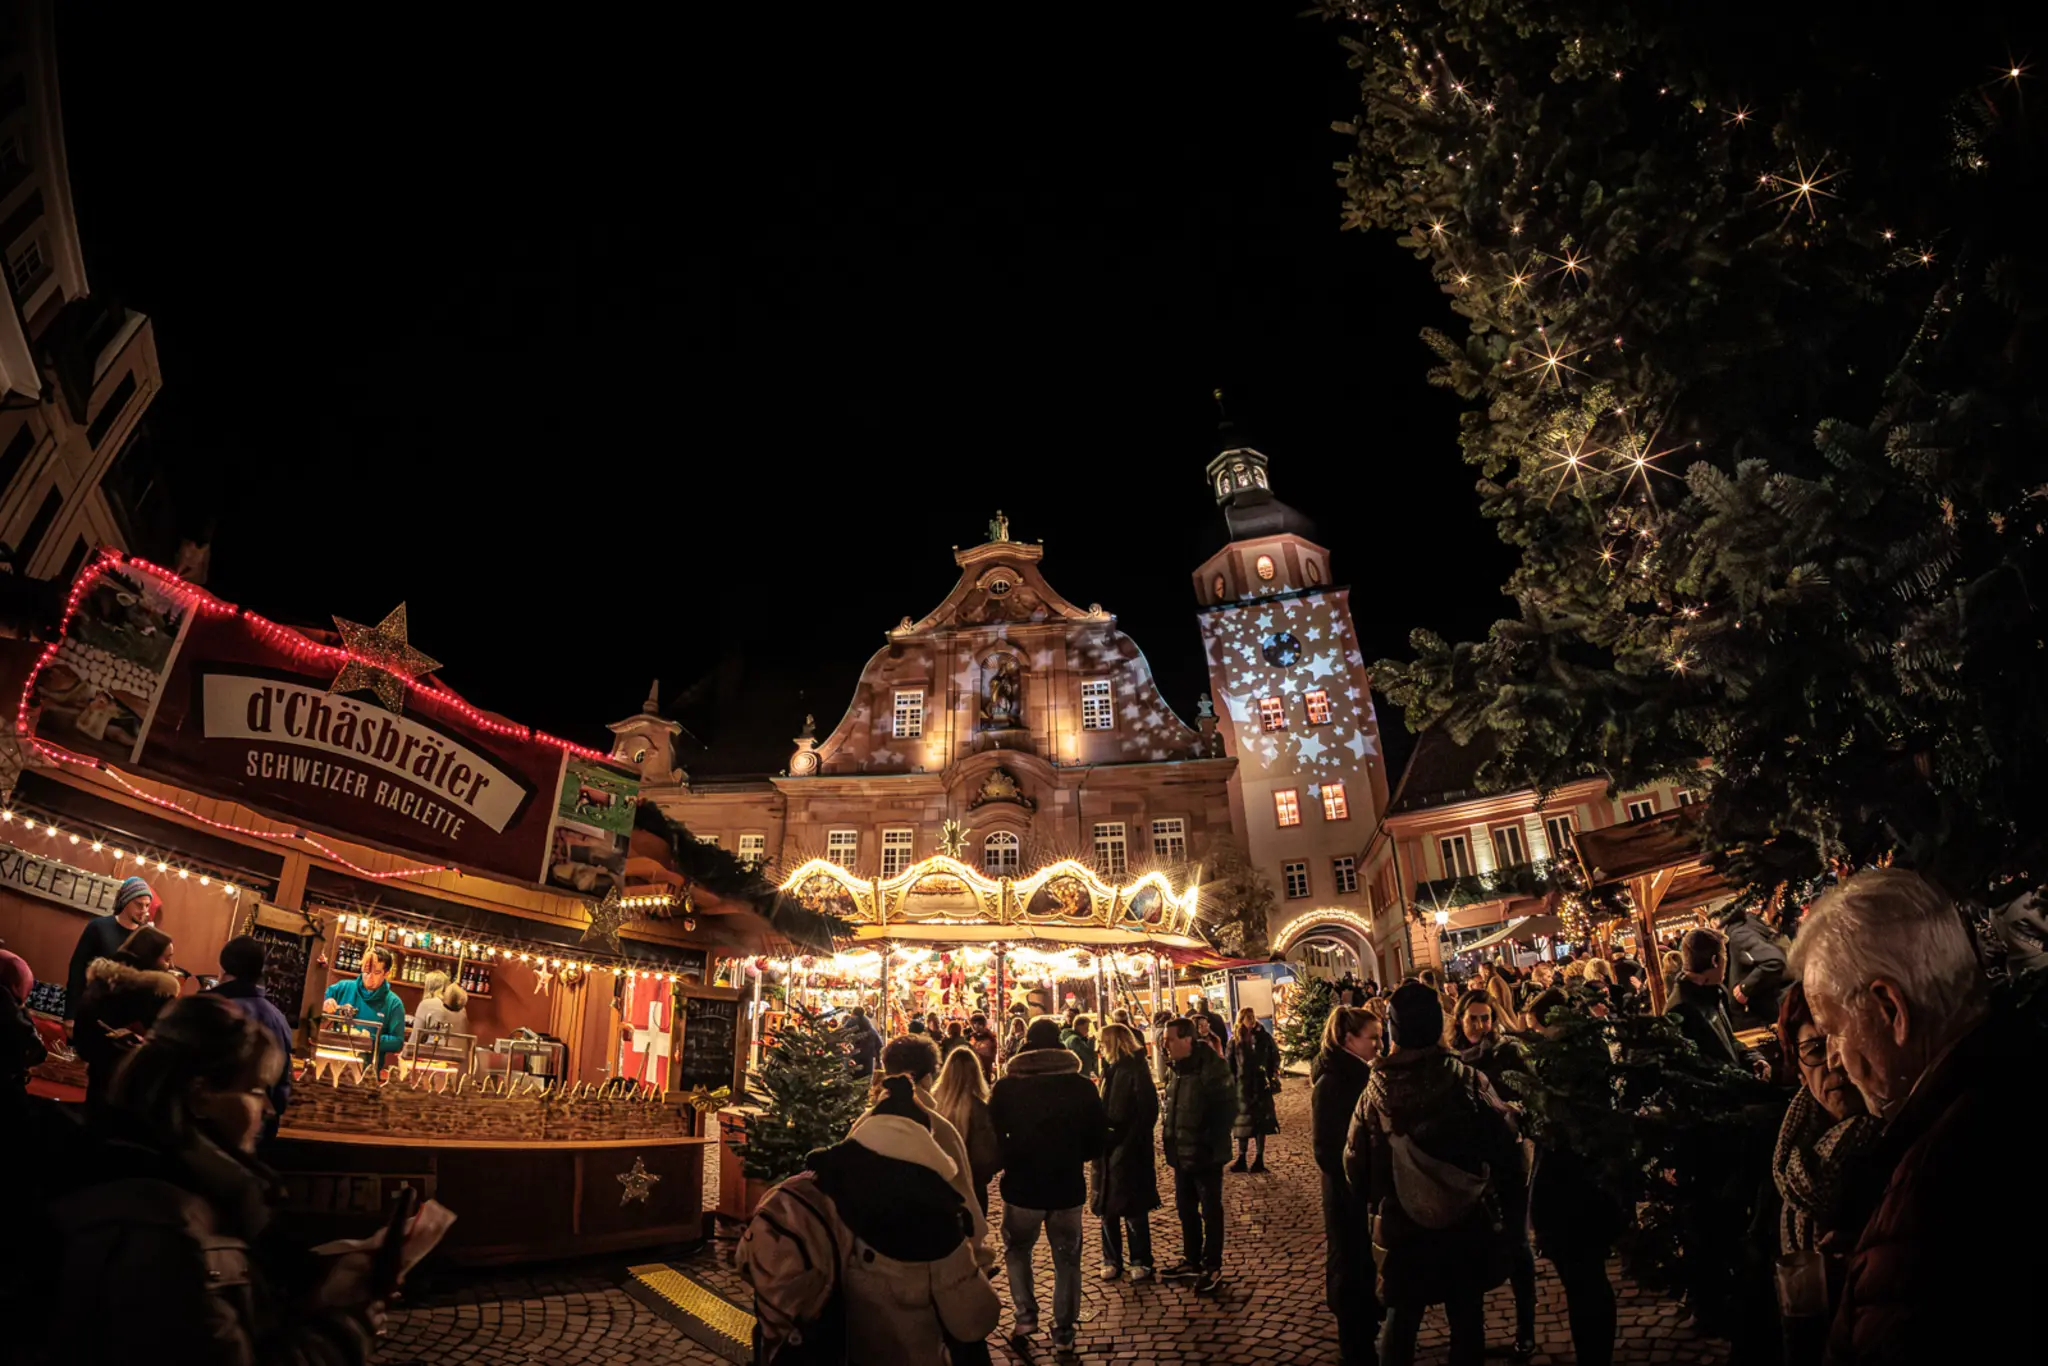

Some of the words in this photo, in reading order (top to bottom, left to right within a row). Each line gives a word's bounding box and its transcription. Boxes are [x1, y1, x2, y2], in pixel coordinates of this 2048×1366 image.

[247, 687, 489, 806] d'Chäsbräter
[246, 750, 369, 799] SCHWEIZER
[374, 780, 466, 841] RACLETTE
[0, 850, 114, 911] RACLETTE
